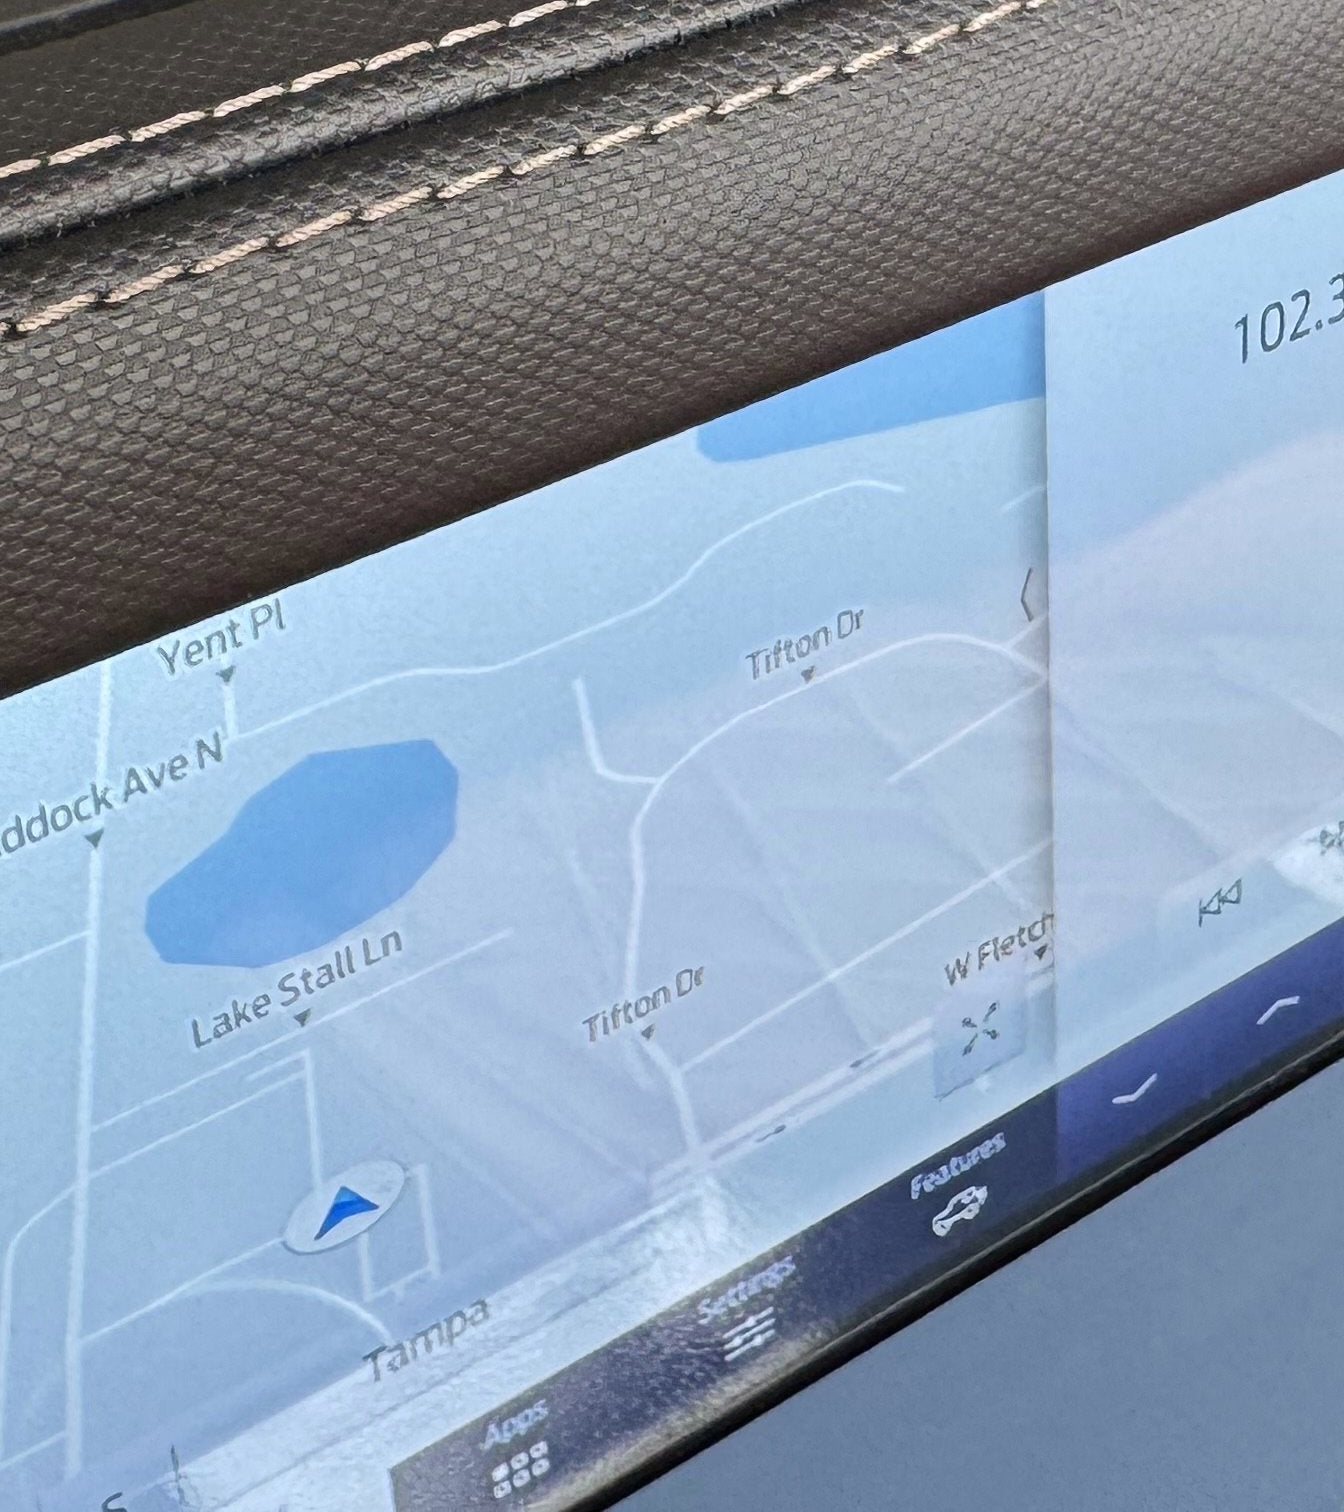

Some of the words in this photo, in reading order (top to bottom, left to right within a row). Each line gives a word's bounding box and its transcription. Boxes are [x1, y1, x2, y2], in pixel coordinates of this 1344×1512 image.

[156, 619, 243, 675] Yent
[251, 597, 285, 640] Pl
[745, 626, 832, 680] Tifton
[837, 609, 864, 640] Dr
[123, 753, 188, 803] Ave
[196, 730, 223, 770] N
[191, 993, 272, 1049] Lake
[277, 945, 356, 1007] Stall
[362, 930, 402, 966] Ln
[582, 985, 671, 1042] Tifton
[675, 966, 704, 997] Dr
[944, 951, 970, 986] W
[910, 1131, 1007, 1200] Features
[362, 1297, 490, 1382] Tampa
[482, 1398, 549, 1451] Apps
